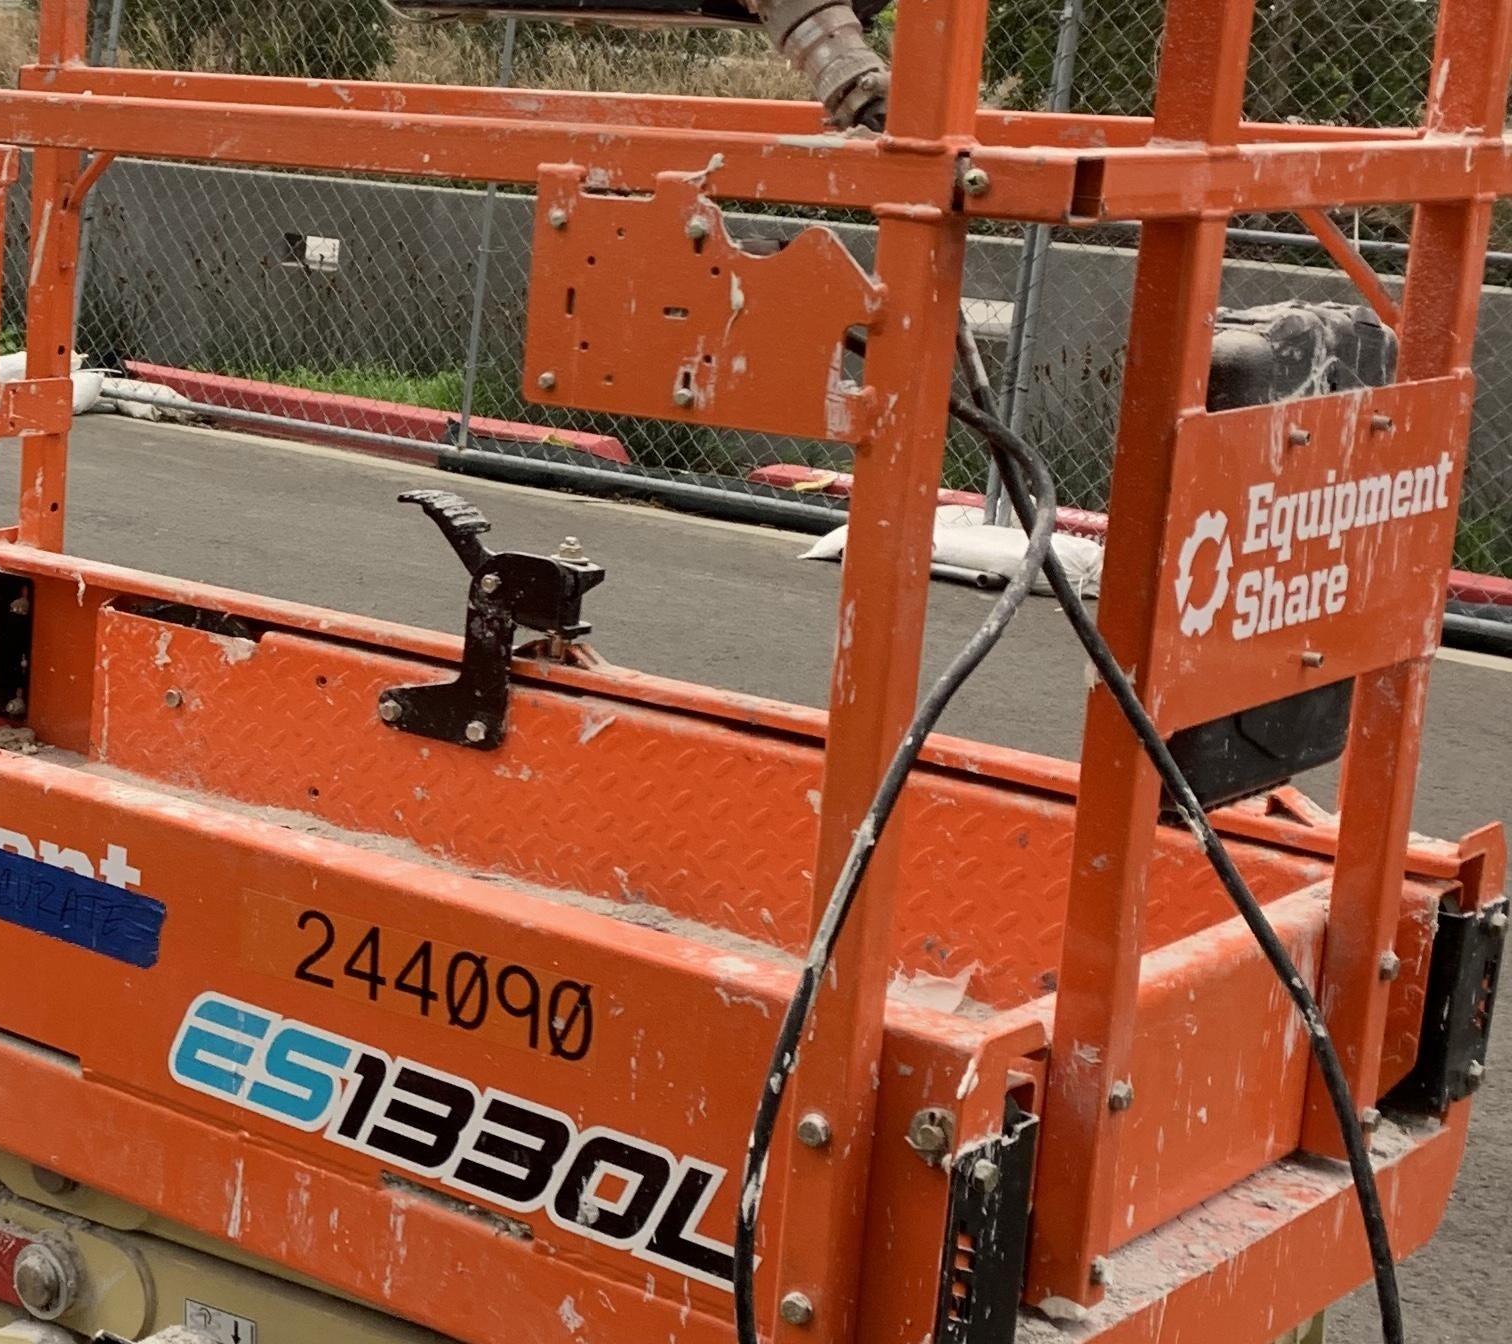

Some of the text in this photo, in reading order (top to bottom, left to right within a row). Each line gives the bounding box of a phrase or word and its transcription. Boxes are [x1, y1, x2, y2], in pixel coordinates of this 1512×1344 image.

[1242, 451, 1453, 562] Equipment
[1232, 563, 1349, 641] Share
[294, 909, 593, 1061] 244090
[174, 998, 738, 1284] ES1330L
